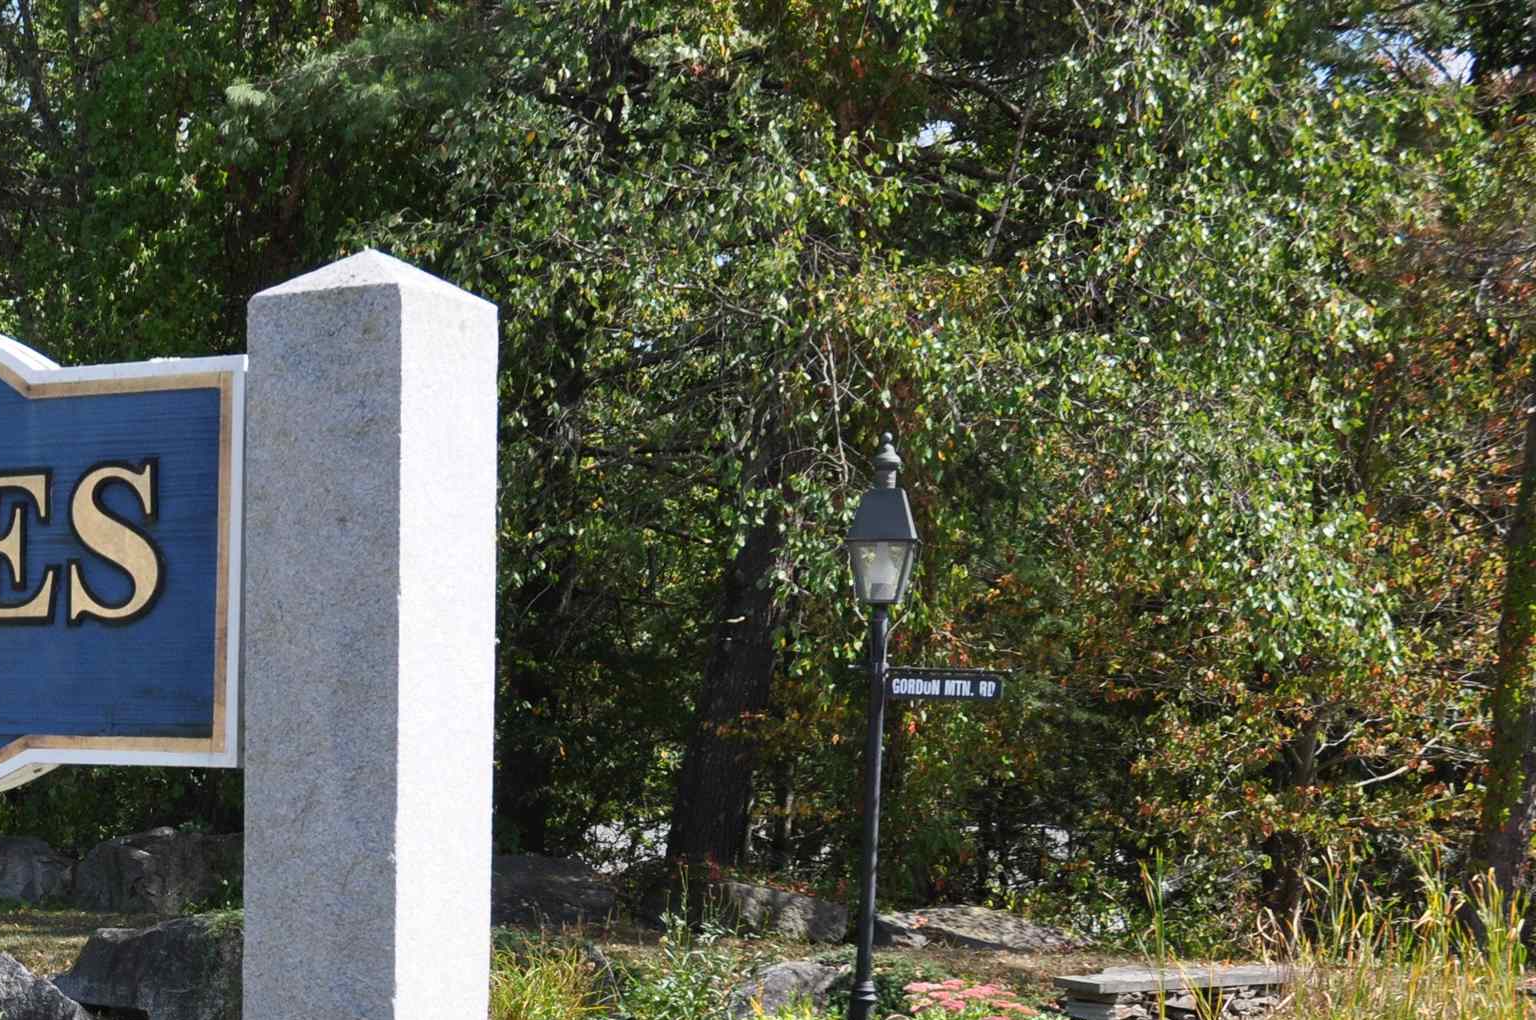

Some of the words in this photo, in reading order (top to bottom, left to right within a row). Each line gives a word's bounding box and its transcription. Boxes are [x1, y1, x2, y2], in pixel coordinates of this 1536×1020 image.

[892, 678, 940, 695] GORDON
[944, 680, 974, 696] MTN.
[979, 681, 996, 697] RD
